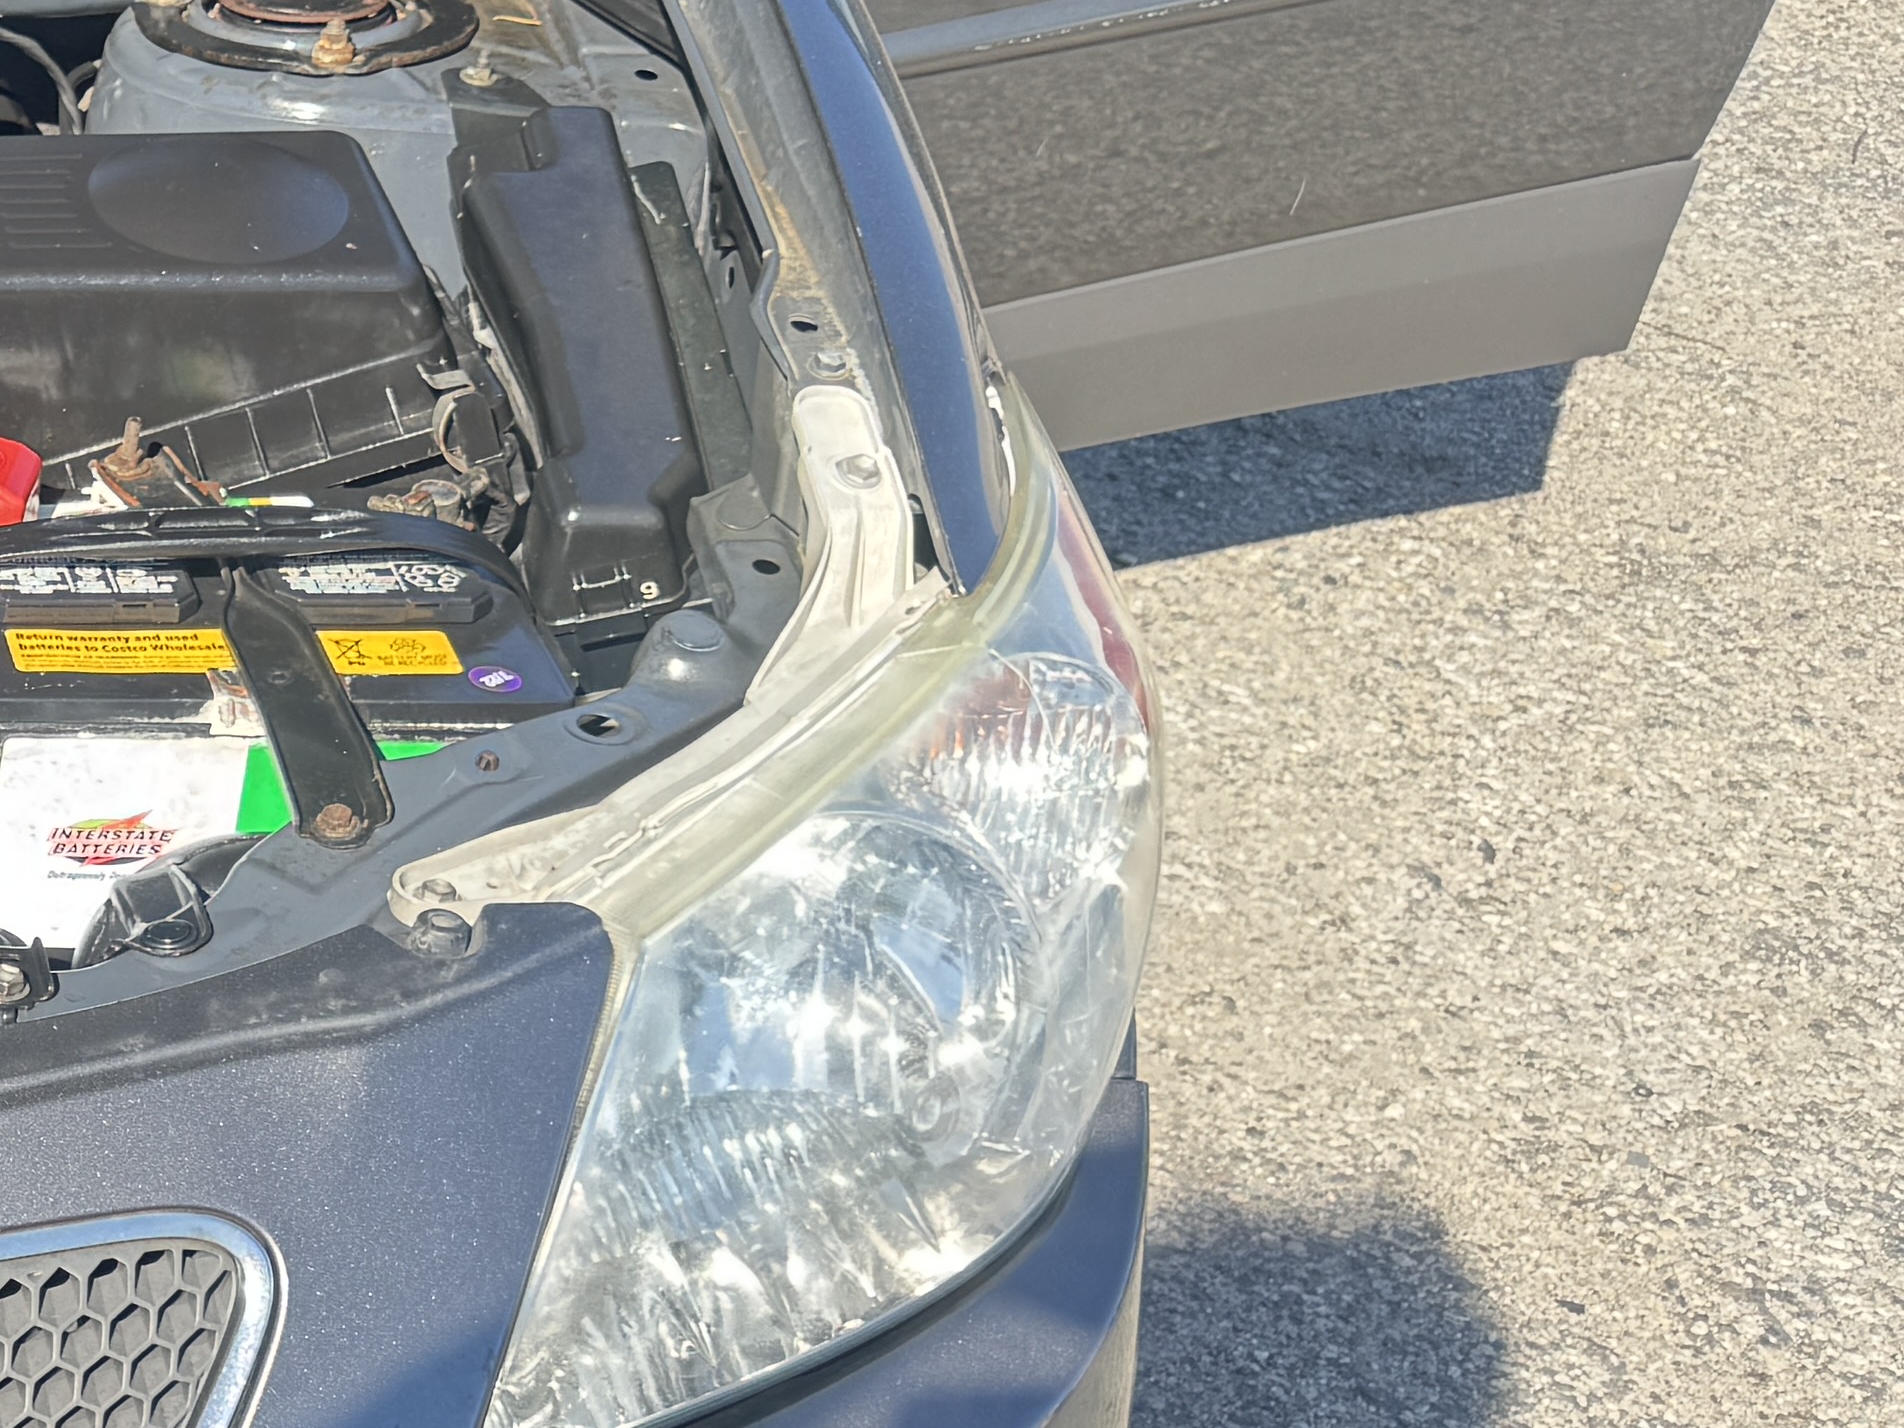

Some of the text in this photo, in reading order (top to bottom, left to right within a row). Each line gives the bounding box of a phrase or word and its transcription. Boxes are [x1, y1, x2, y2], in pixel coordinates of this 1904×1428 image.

[15, 632, 199, 644] Return warranty and used
[18, 643, 225, 652] batteries to Costco Wholesale
[50, 827, 176, 843] INTERSTATE
[52, 842, 163, 855] BATTERIES
